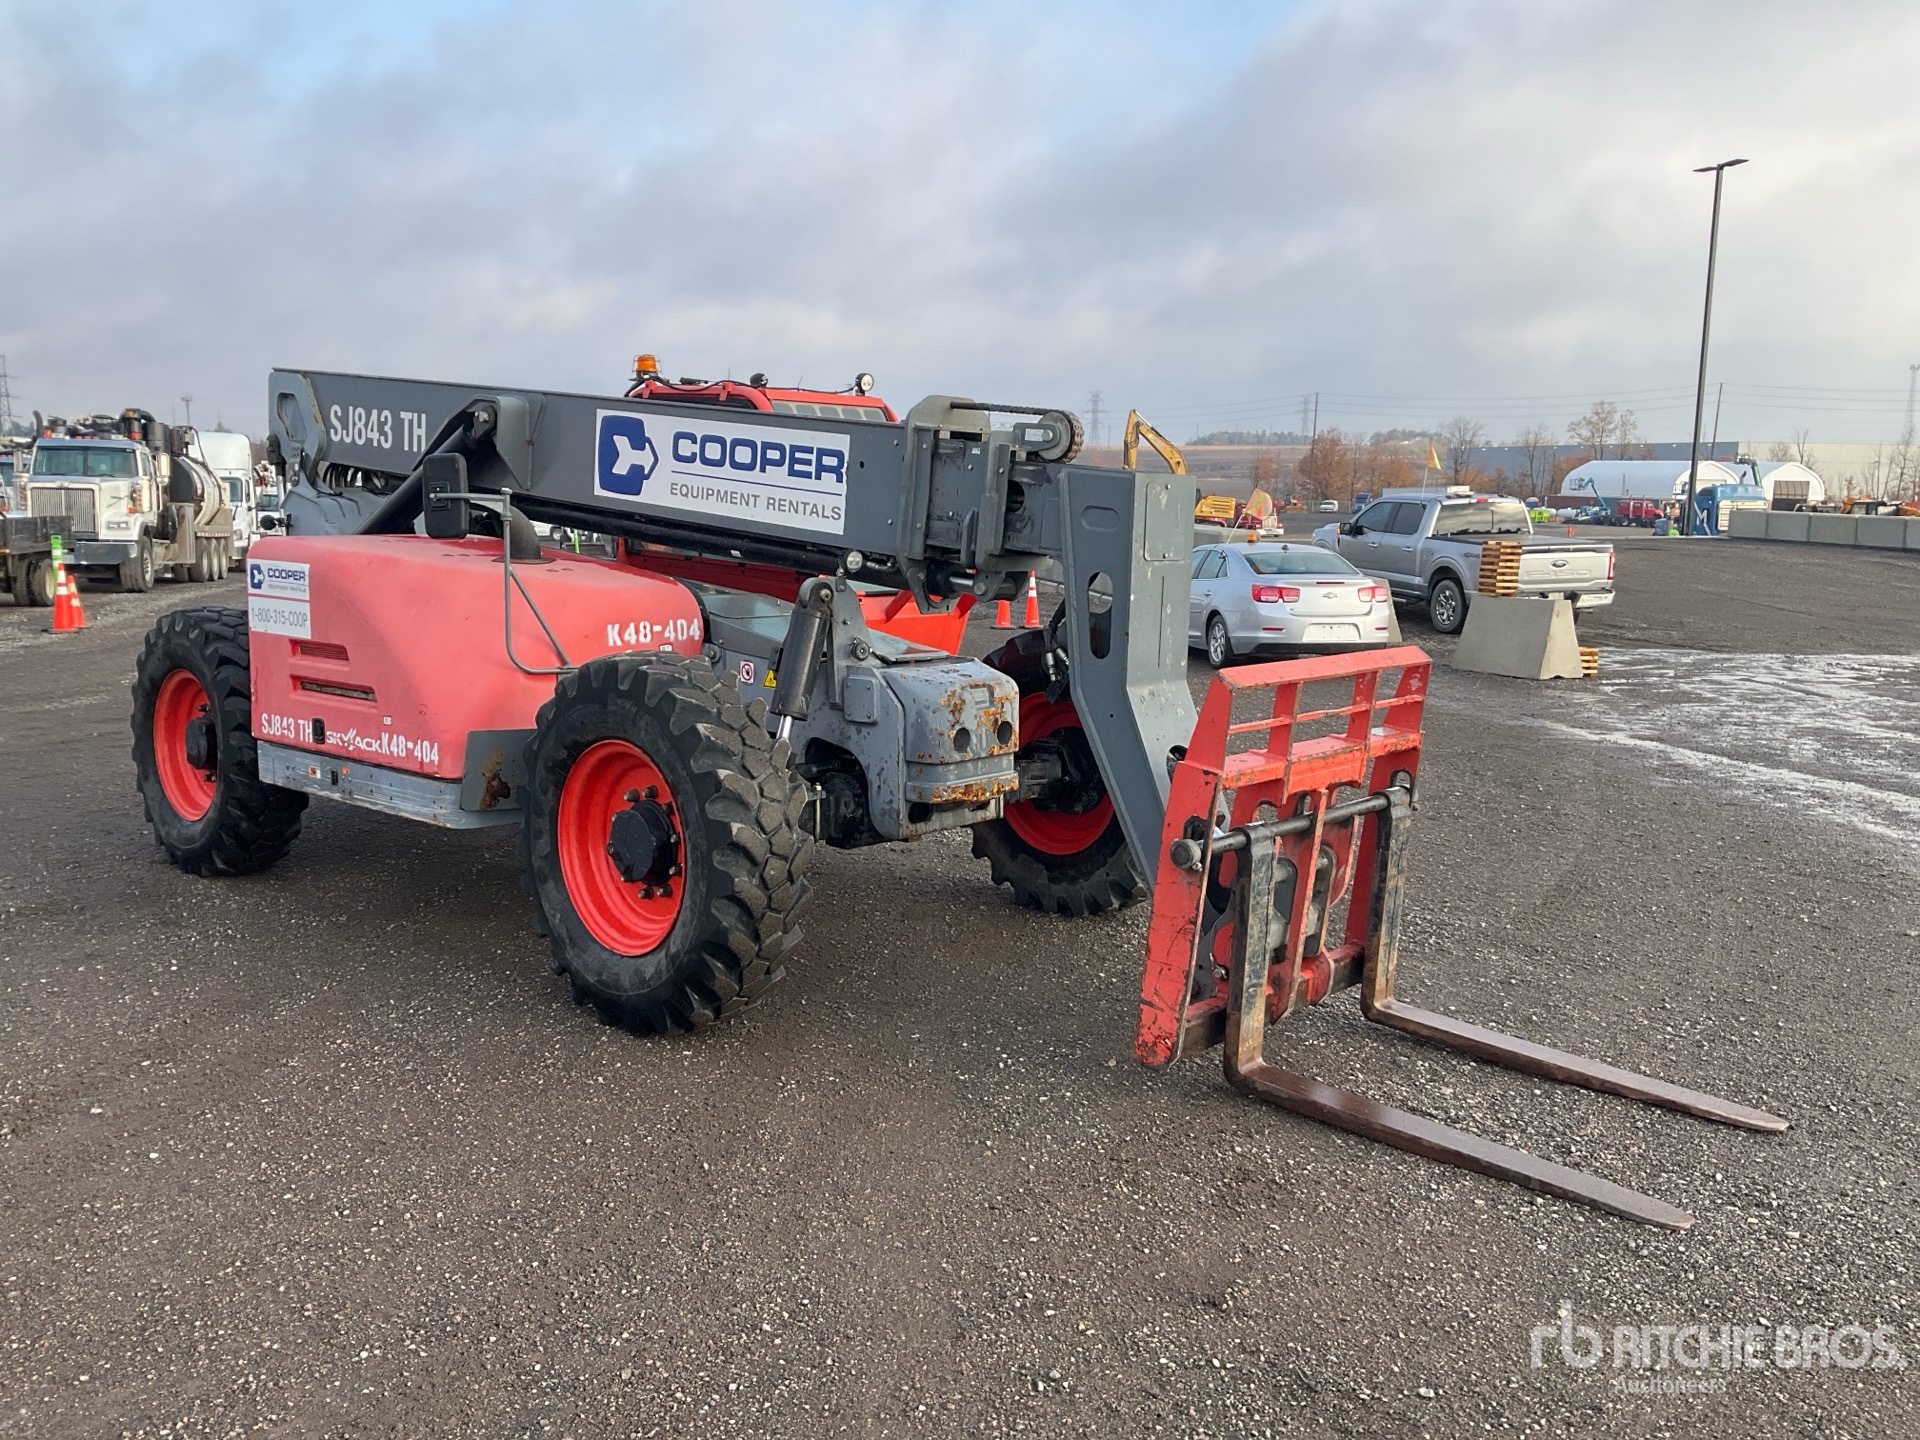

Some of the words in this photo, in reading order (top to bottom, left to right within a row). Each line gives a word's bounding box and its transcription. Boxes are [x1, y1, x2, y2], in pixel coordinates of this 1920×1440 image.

[329, 404, 393, 449] SJ843
[400, 411, 427, 452] TH
[672, 431, 846, 484] COOPER
[670, 482, 760, 509] EQUIPMENT
[766, 495, 842, 521] RENTALS
[267, 567, 306, 582] COOPER
[251, 607, 308, 628] 1-800-315-COOP
[607, 618, 700, 646] K48-404
[261, 712, 295, 739] SJ843
[298, 718, 313, 743] TH
[381, 732, 439, 766] K48-404
